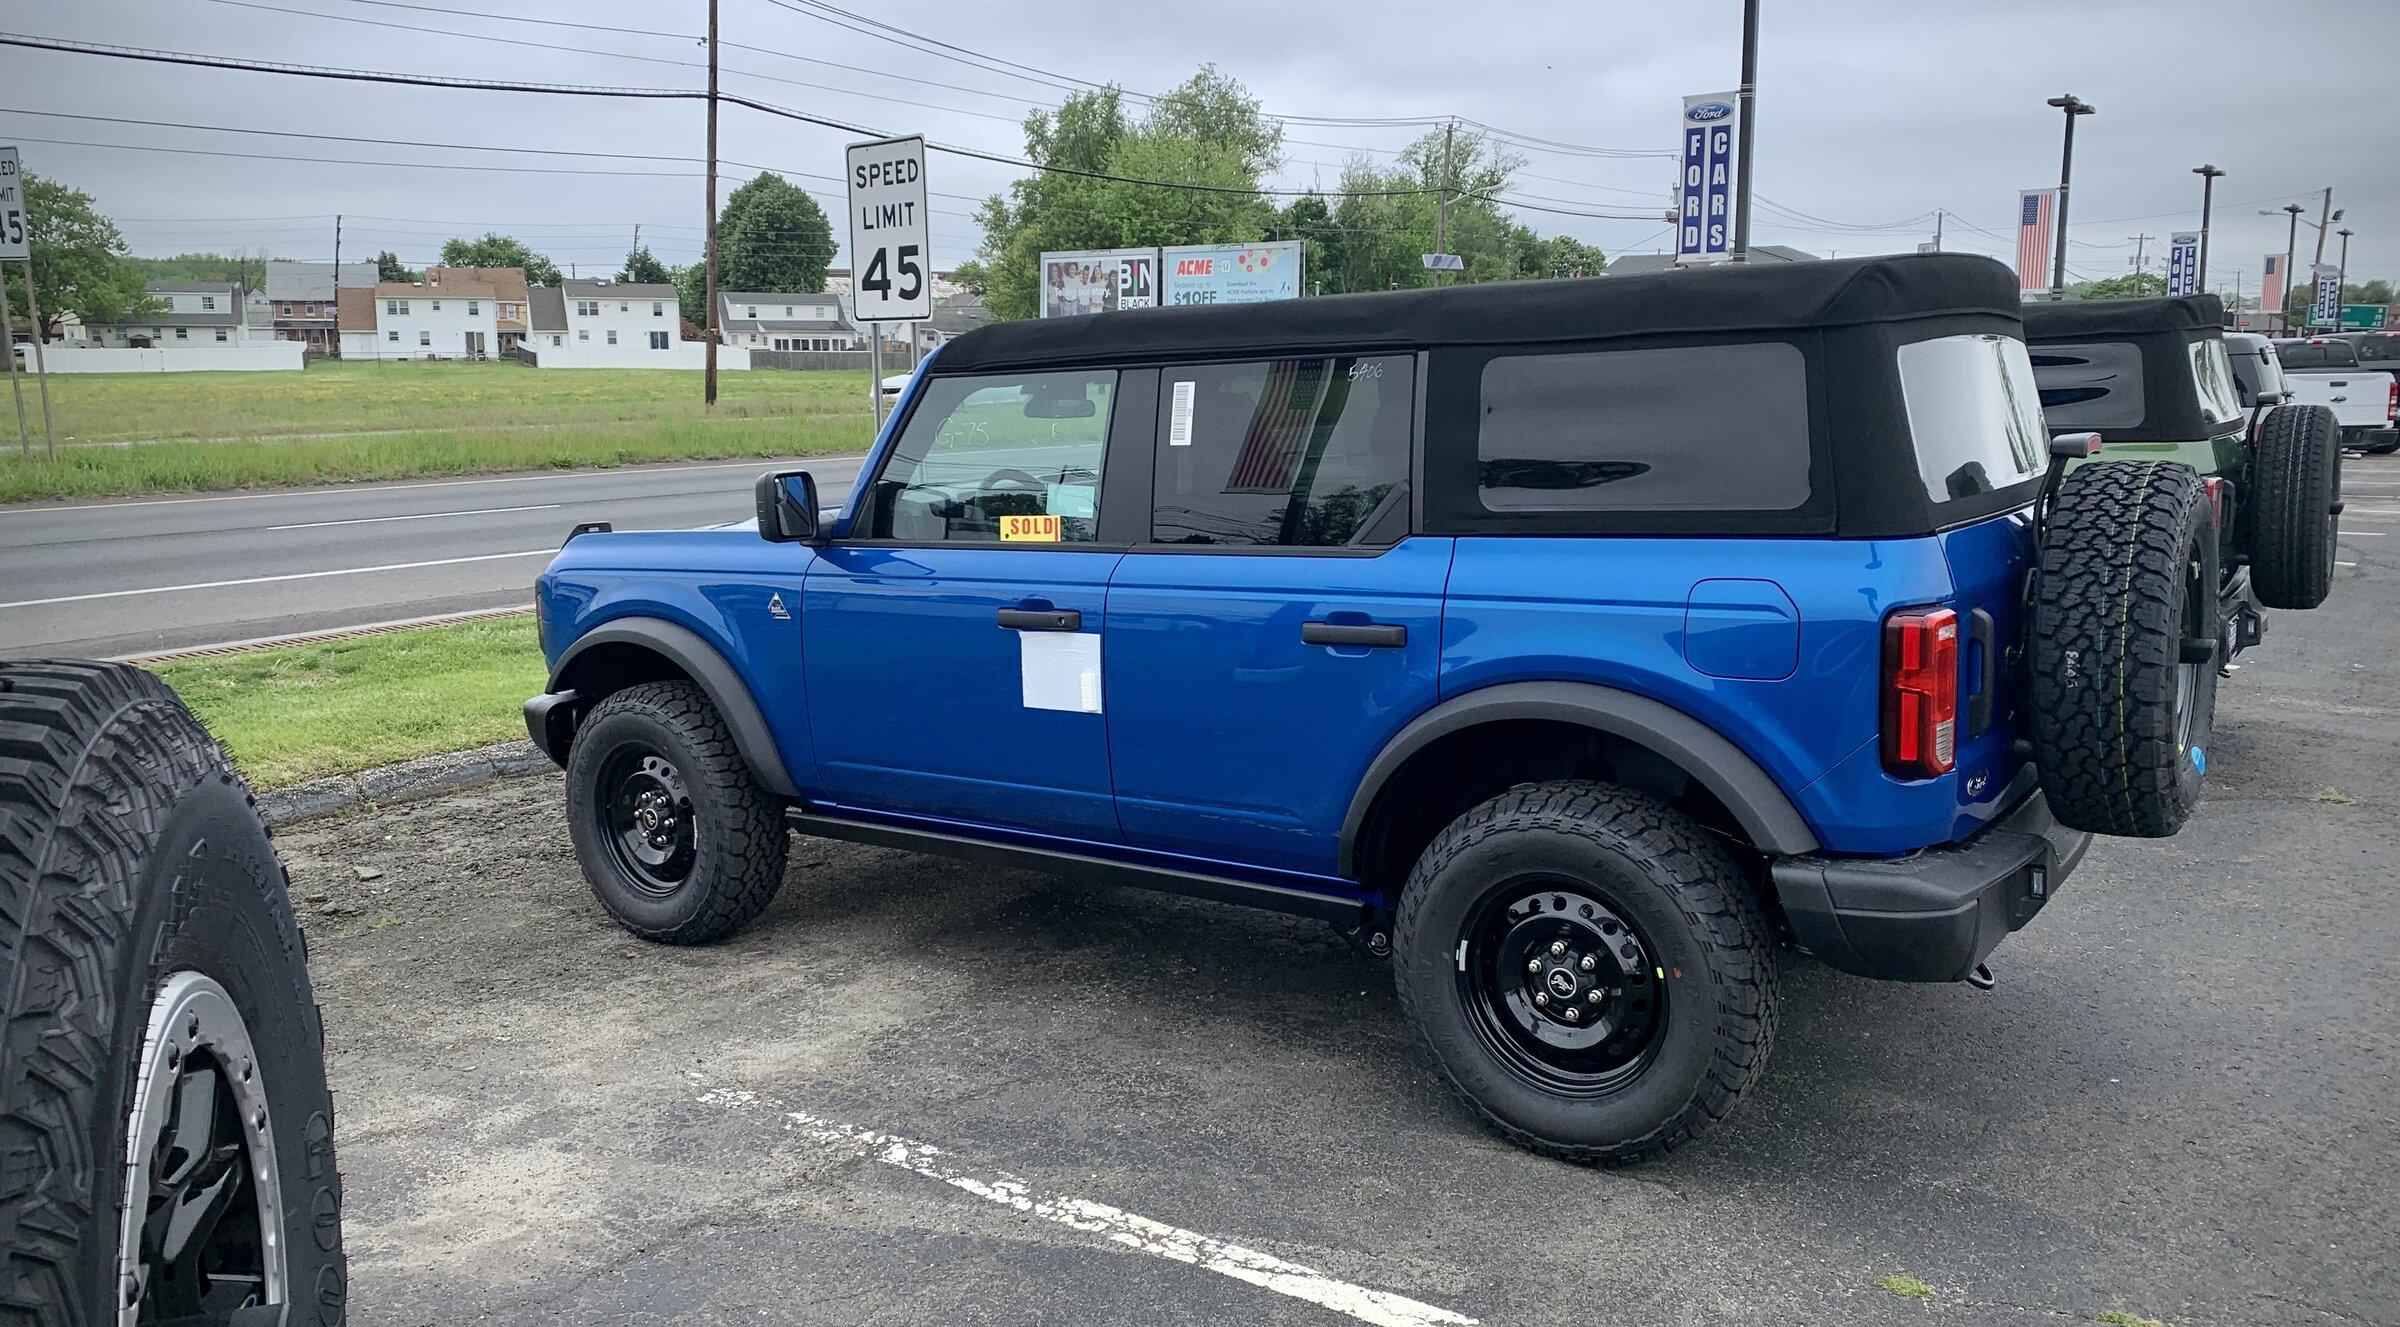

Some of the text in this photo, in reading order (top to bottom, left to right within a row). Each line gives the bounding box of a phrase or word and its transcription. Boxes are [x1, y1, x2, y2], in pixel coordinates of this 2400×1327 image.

[1694, 106, 1724, 120] Ford
[855, 157, 919, 189] SPEED
[1685, 133, 1701, 248] FORD
[1710, 131, 1728, 247] CARS
[862, 201, 915, 230] LIMIT
[861, 244, 922, 301] 45
[1176, 259, 1213, 276] ACME
[1121, 299, 1150, 309] BLACK
[1010, 517, 1053, 535] SOLD
